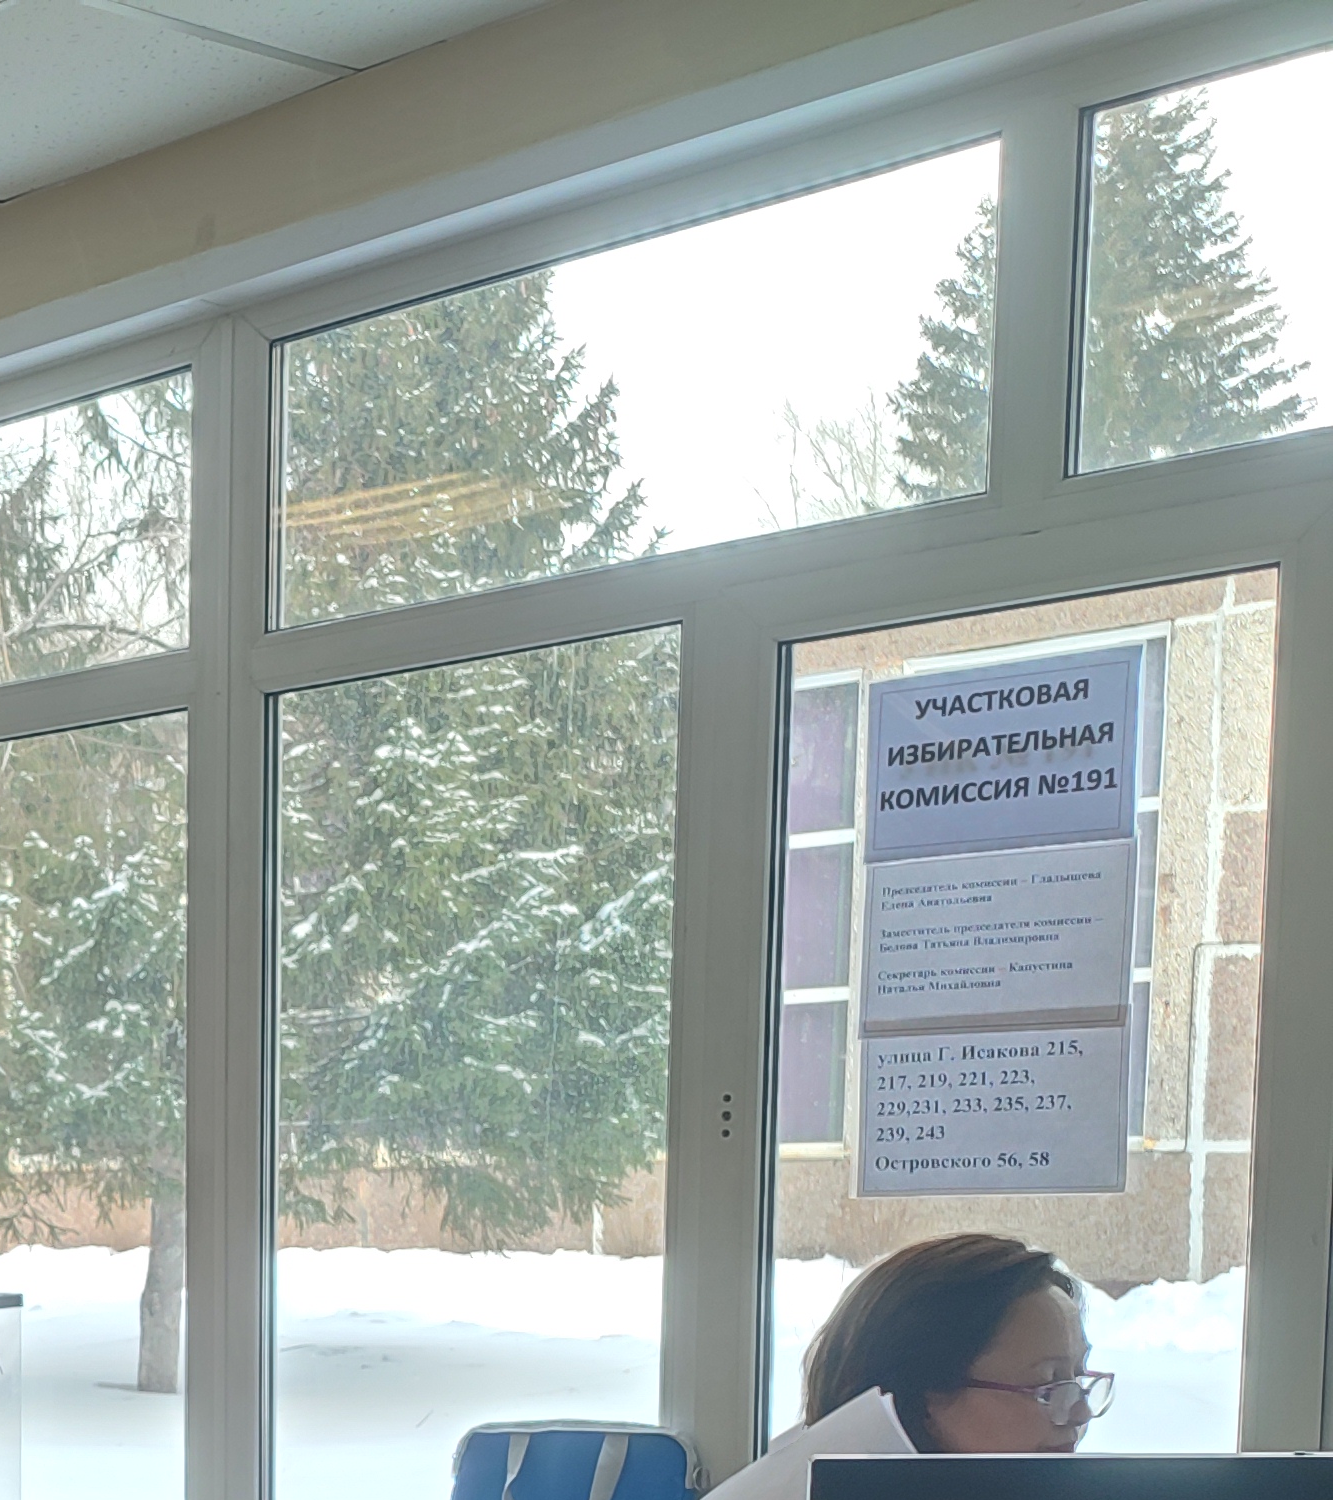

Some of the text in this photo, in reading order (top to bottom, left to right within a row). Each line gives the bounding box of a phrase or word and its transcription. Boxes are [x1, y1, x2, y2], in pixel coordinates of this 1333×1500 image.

[915, 678, 1089, 720] УЧАСТКОВАЯ
[887, 721, 1114, 767] ИЗБИРАТЕЛЬНАЯ
[879, 767, 1118, 812] КОМИССИЯ №191
[882, 882, 958, 898] Председатель
[961, 877, 1018, 890] комиссии
[881, 893, 993, 912] Елена Анатольевна
[880, 926, 951, 939] Заместитель
[953, 920, 1030, 935] председателя
[1033, 916, 1092, 929] комиссии
[923, 937, 969, 950] Татьяна
[973, 932, 1060, 947] Владимировна
[877, 968, 937, 983] Секретарь
[940, 964, 996, 977] комиссии
[1008, 959, 1073, 975] Капустина
[877, 978, 1001, 996] Наталья Михайловна
[877, 1039, 1084, 1068] улица Г. Исакова 215,
[876, 1068, 1035, 1091] 217, 219, 221, 223,
[876, 1094, 1072, 1117] 229,231, 233, 235, 237,
[875, 1125, 945, 1144] 239, 243
[874, 1151, 1051, 1174] Островского 56, 58
